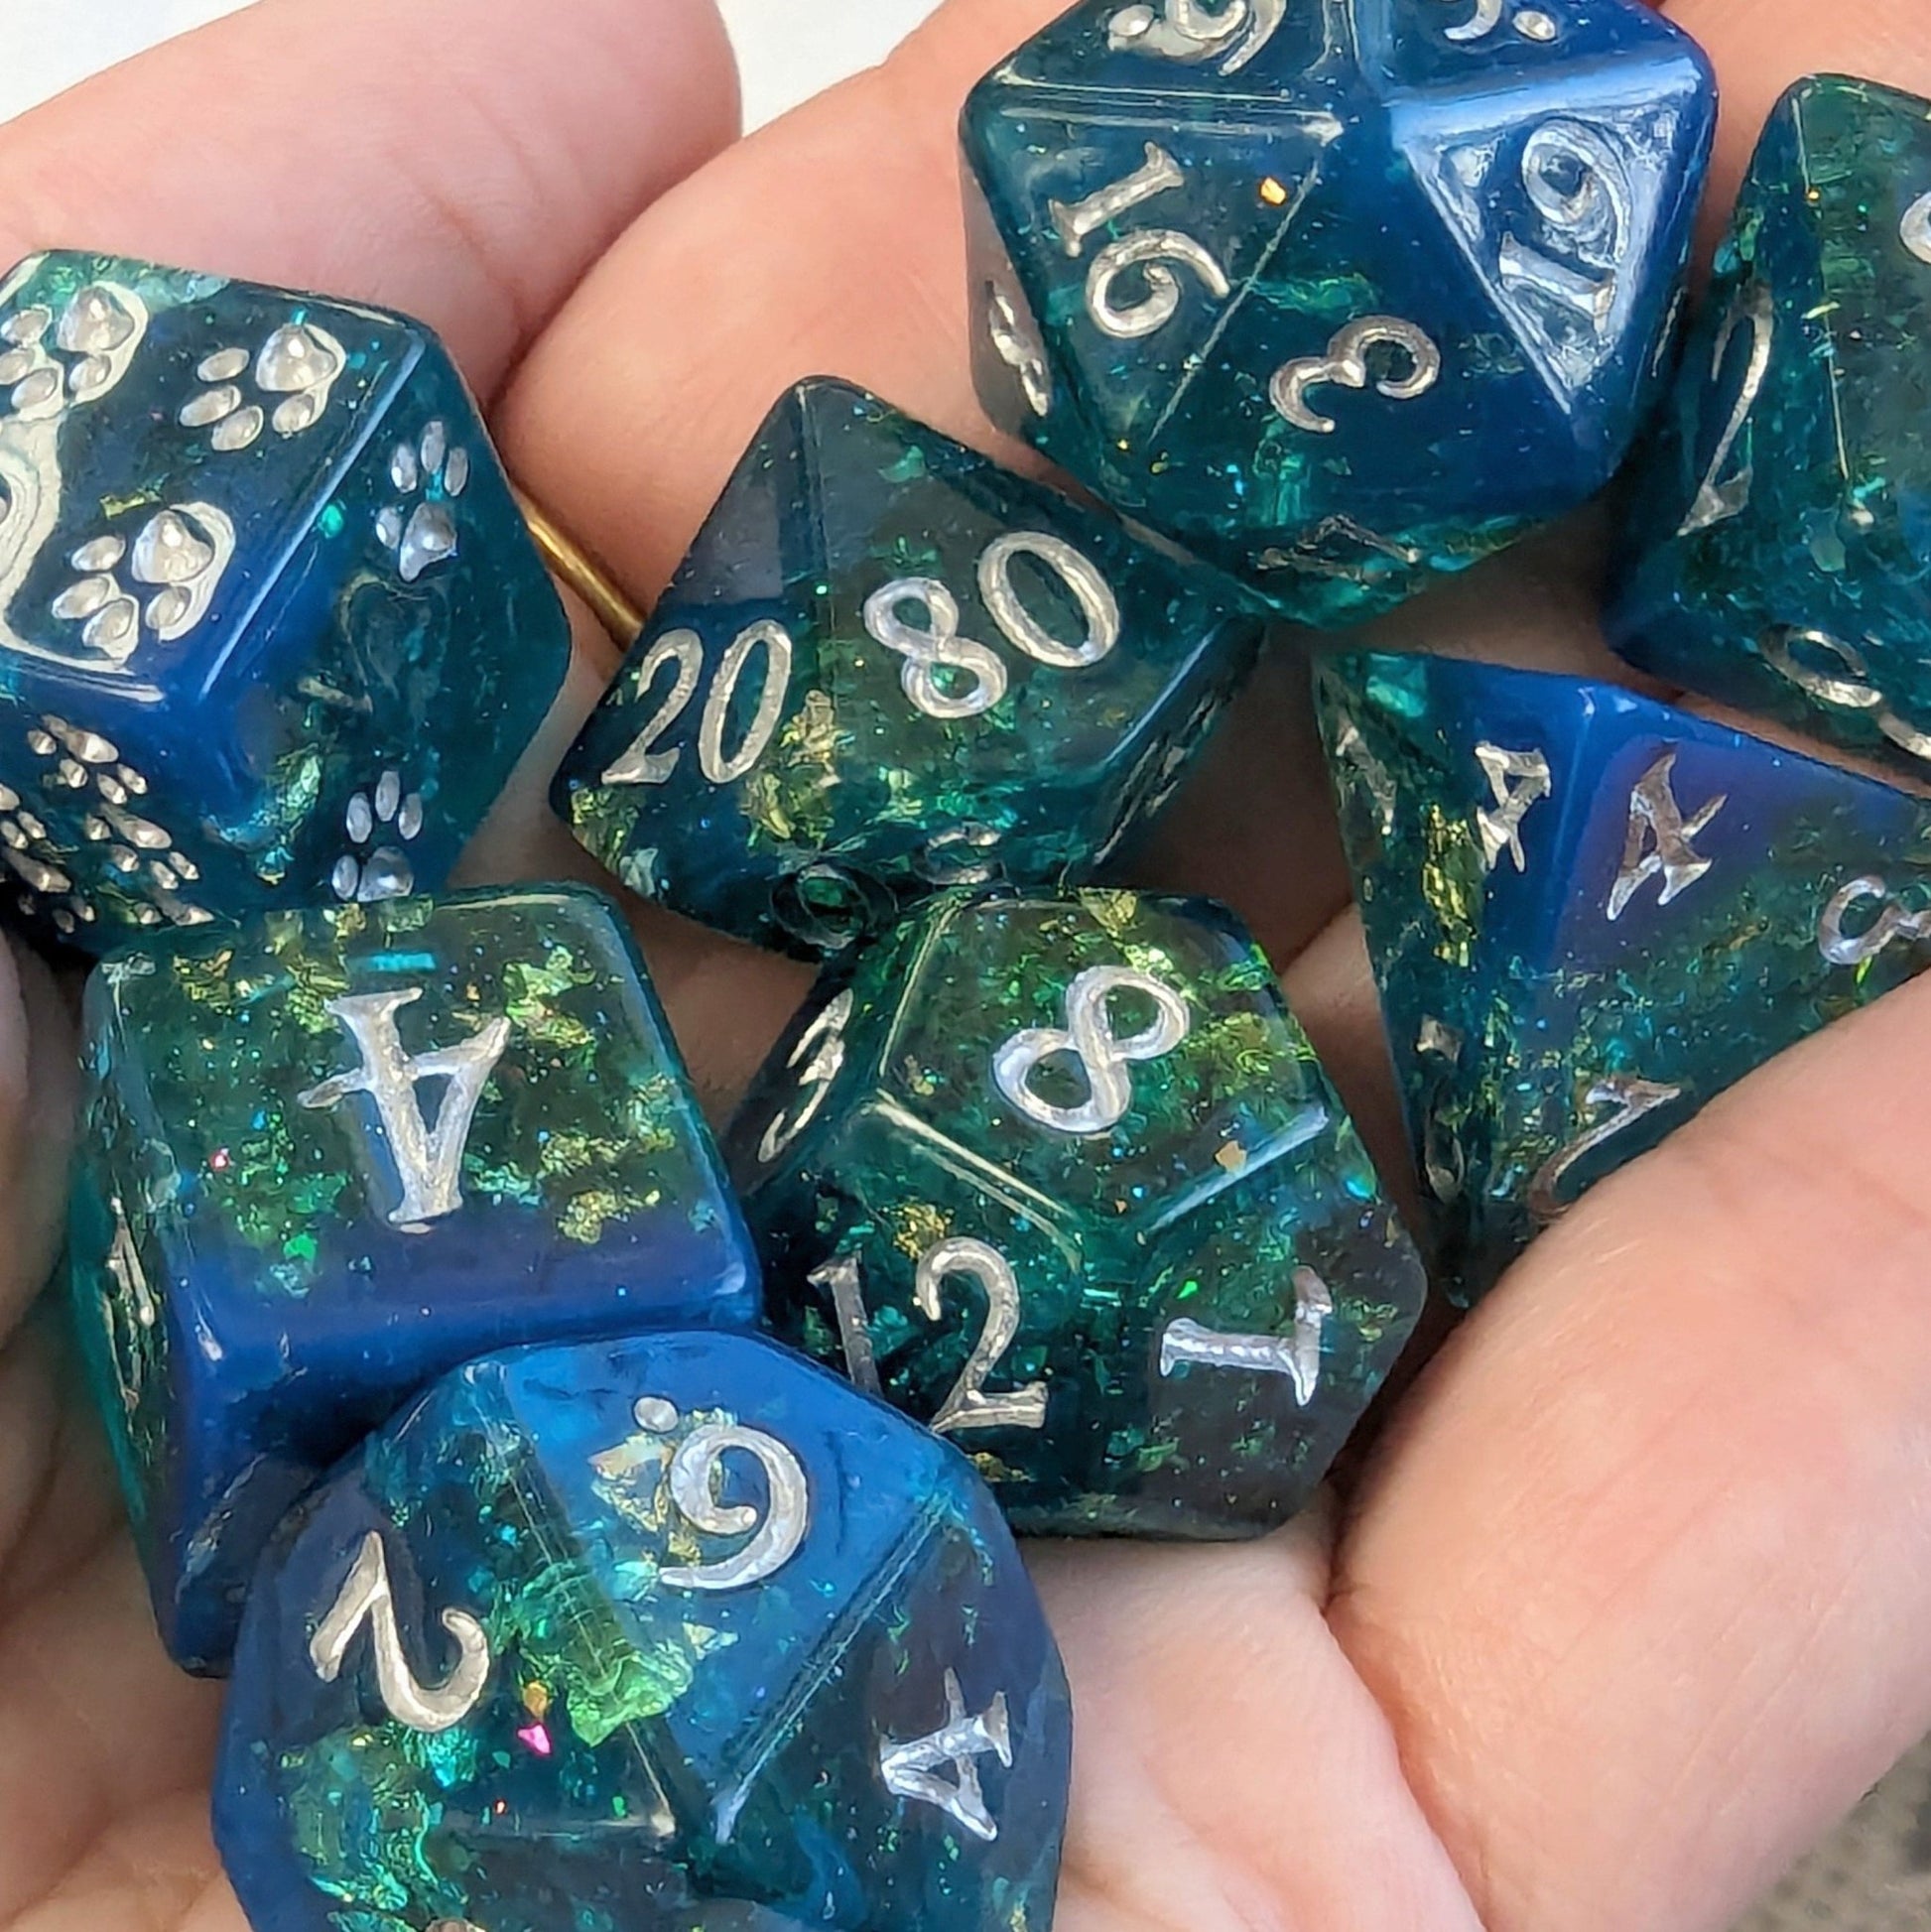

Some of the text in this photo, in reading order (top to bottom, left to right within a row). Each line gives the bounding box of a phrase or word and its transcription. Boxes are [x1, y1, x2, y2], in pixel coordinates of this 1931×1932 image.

[1049, 142, 1229, 338] 16
[1498, 117, 1632, 337] 19
[1269, 315, 1441, 433] 3
[600, 618, 793, 784] 20
[863, 531, 1121, 718] 80
[1475, 740, 1552, 873] 4
[1607, 743, 1729, 922] 4
[297, 987, 512, 1228] 4
[993, 964, 1191, 1137] 8
[807, 1233, 1050, 1433] 12
[310, 1530, 490, 1733] 2
[880, 1667, 1015, 1841] 4
